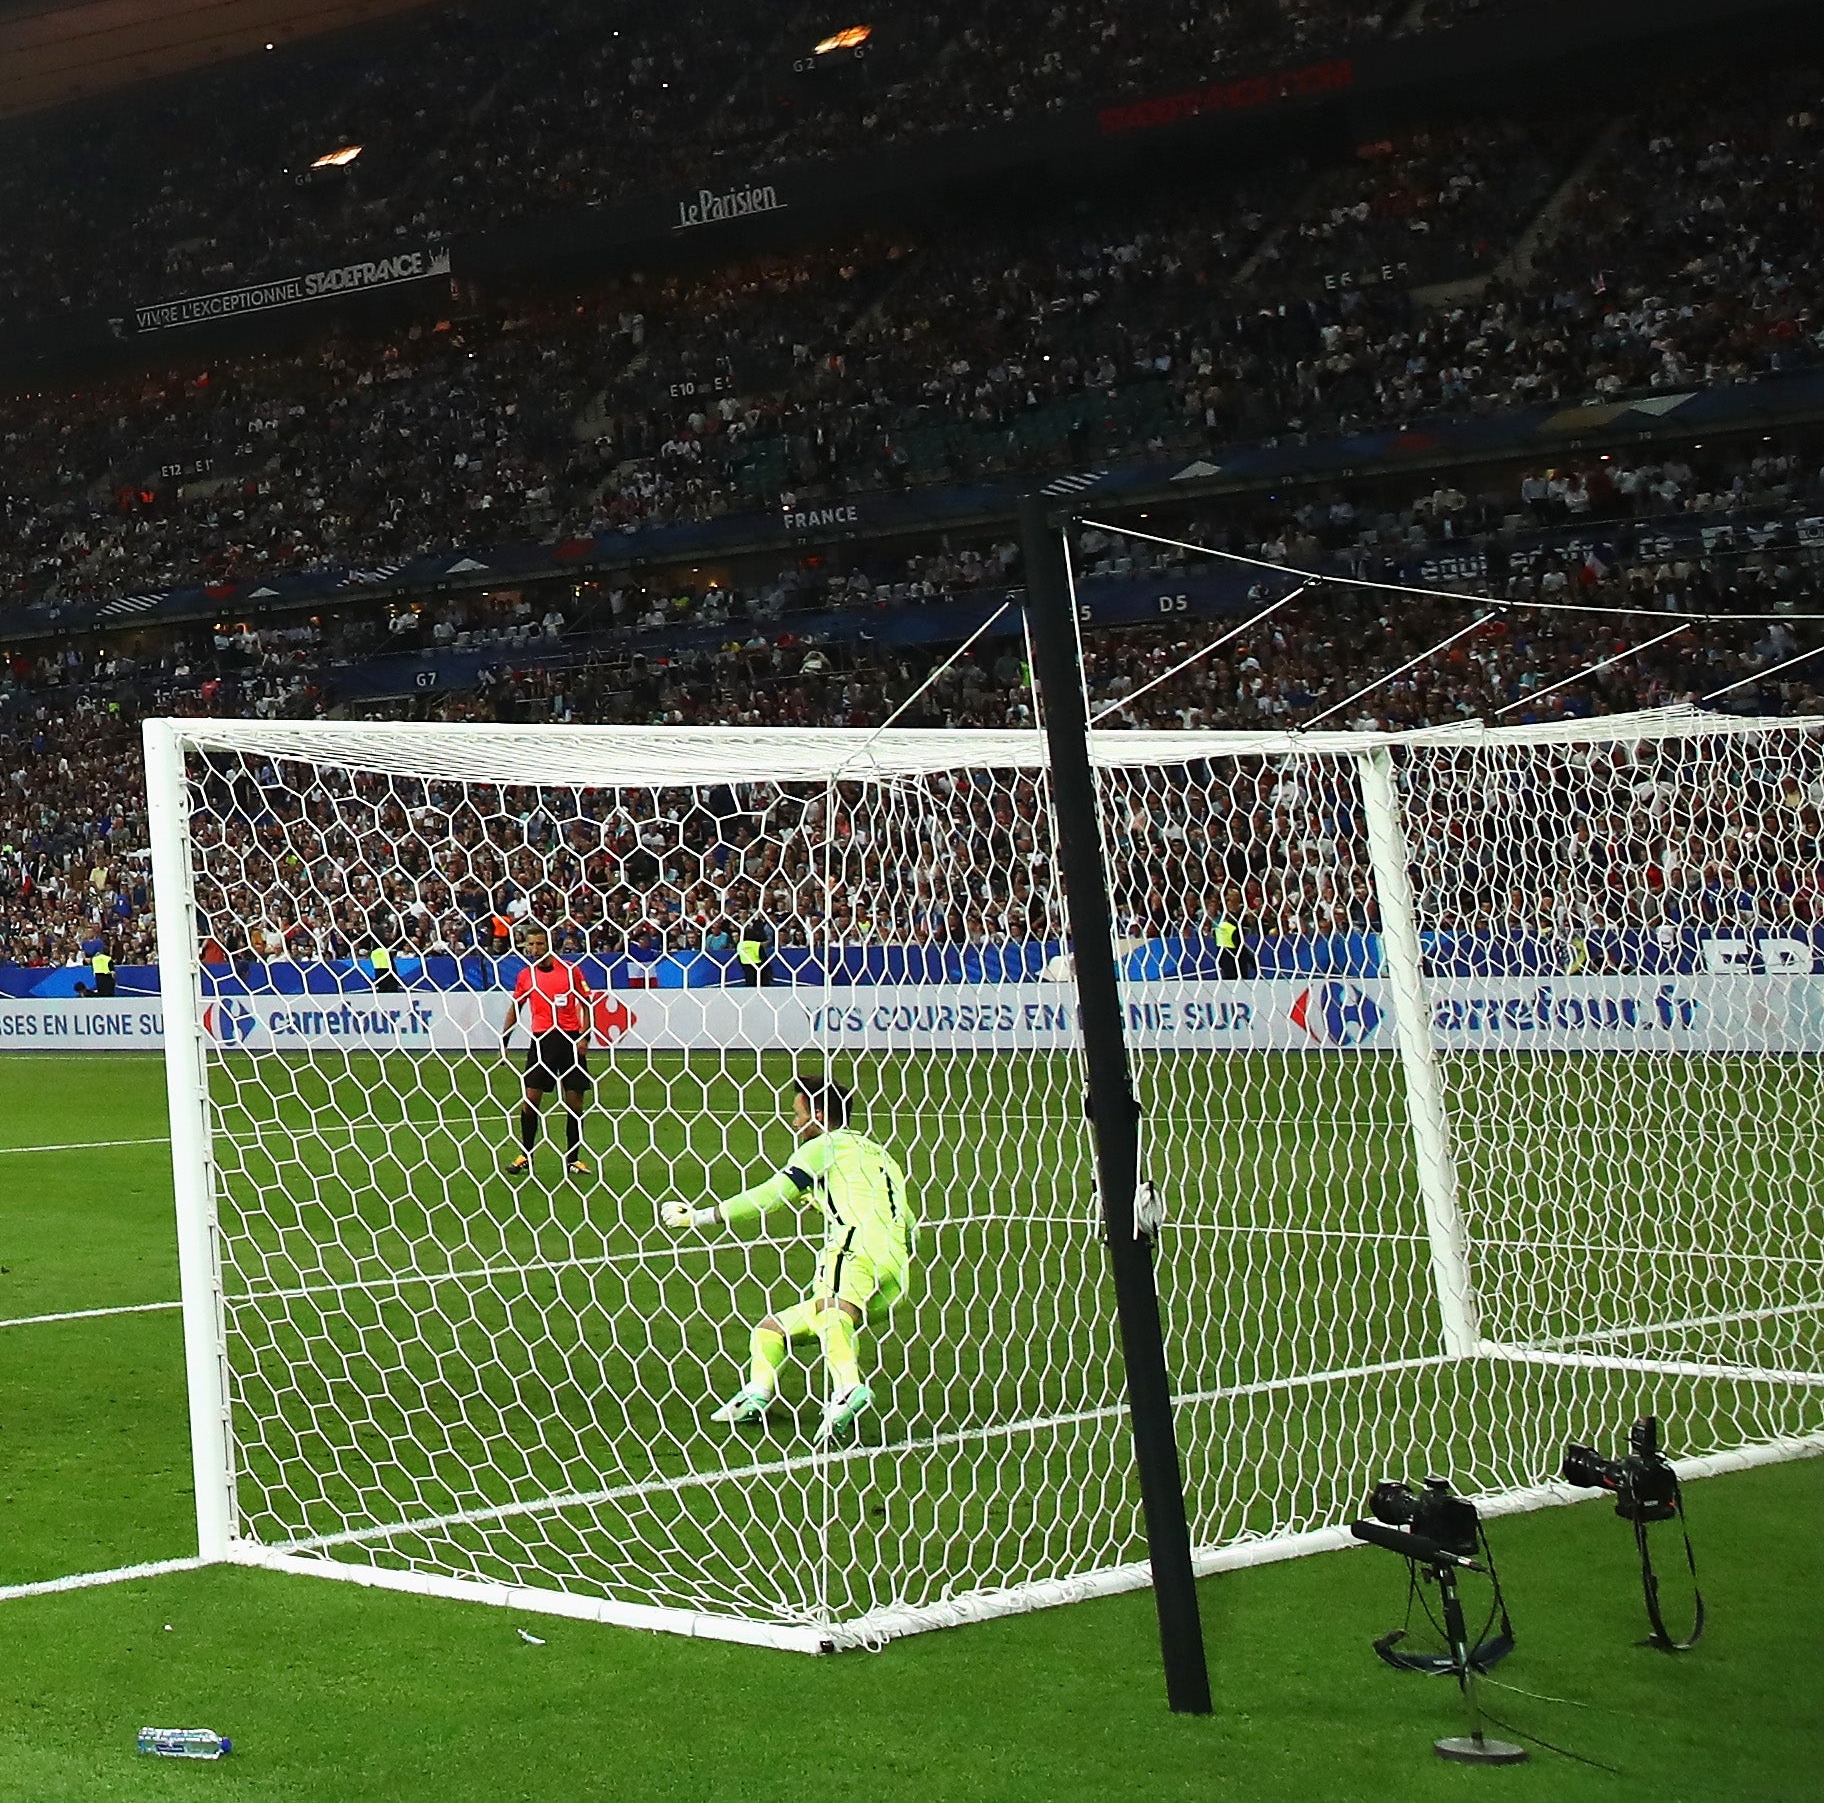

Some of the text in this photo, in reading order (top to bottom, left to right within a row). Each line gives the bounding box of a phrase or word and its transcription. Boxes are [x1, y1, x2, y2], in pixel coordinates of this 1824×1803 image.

[698, 183, 777, 222] Parisien
[137, 251, 423, 329] VIVRE L'EXCEPTIONNEL STADEFRANCE
[669, 381, 695, 398] E10
[784, 505, 858, 529] FRANCE
[1159, 595, 1188, 615] D5
[415, 672, 438, 691] G7
[269, 1001, 433, 1035] carrefour.fr
[811, 1006, 863, 1031] VOS
[873, 1005, 1014, 1030] COURSES
[1026, 1005, 1065, 1029] EN
[1185, 1003, 1252, 1029] SUR
[1432, 985, 1698, 1031] arrefour.fr
[44, 1015, 67, 1035] EN
[74, 1015, 132, 1035] LIGNE
[139, 1014, 164, 1034] SU
